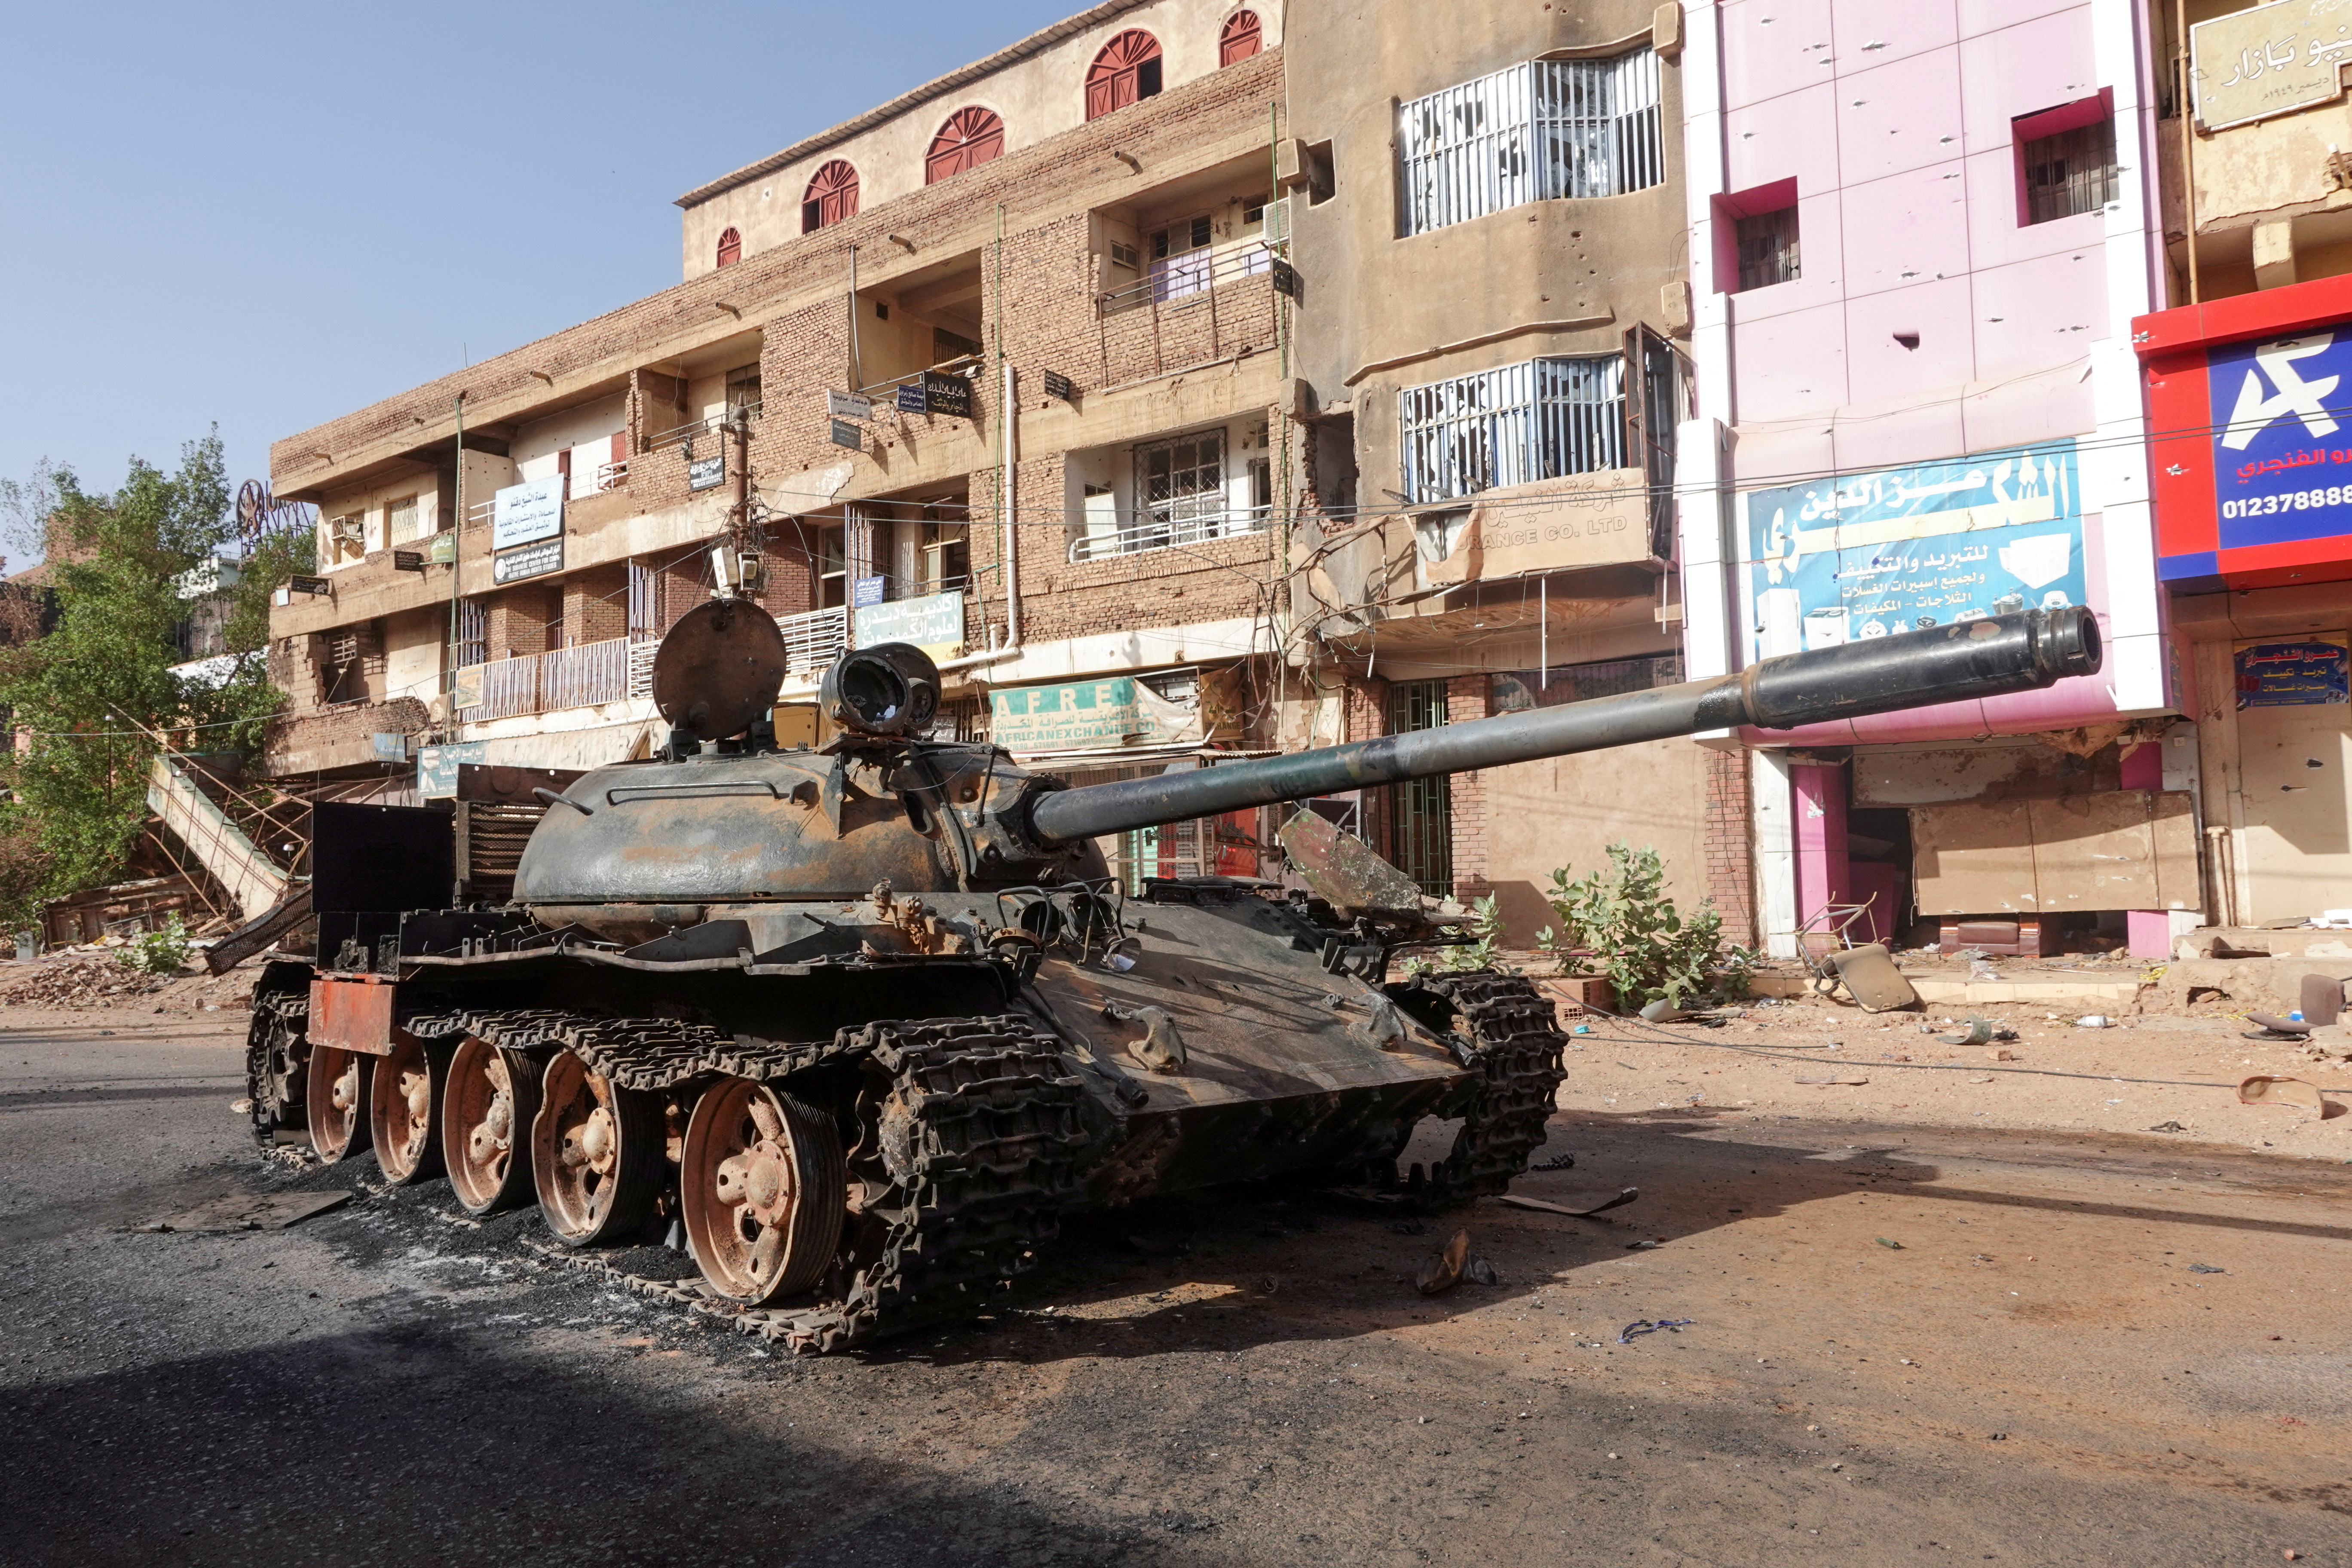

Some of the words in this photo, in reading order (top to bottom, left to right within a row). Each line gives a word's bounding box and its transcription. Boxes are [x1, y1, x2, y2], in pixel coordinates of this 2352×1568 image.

[2221, 34, 2297, 87] بازار
[2296, 77, 2329, 94] ديسمبر
[2236, 448, 2325, 484] الفنجري
[521, 492, 534, 508] الشيخ
[1565, 472, 1626, 512] شركة
[1800, 478, 1883, 522] الدين
[2223, 484, 2352, 519] 012378888
[1456, 529, 1537, 551] URANCE
[1544, 524, 1580, 541] CO.
[1588, 515, 1627, 535] LTD
[512, 562, 528, 571] SUDANESE
[529, 559, 541, 567] CENTER
[1923, 544, 1988, 570] للتبريد
[531, 565, 542, 573] RIGHTS
[542, 562, 557, 571] STUDIES
[1941, 572, 1985, 590] ولجميع
[1853, 600, 1901, 616] المكيفات
[1916, 591, 1972, 608] الثلاجات
[858, 605, 900, 631] دندرة
[928, 614, 958, 643] لعلوم
[2303, 649, 2339, 663] عمرو
[995, 718, 1034, 733] المحدودة
[1038, 713, 1075, 729] للصرافة
[1135, 721, 1161, 733] CO.
